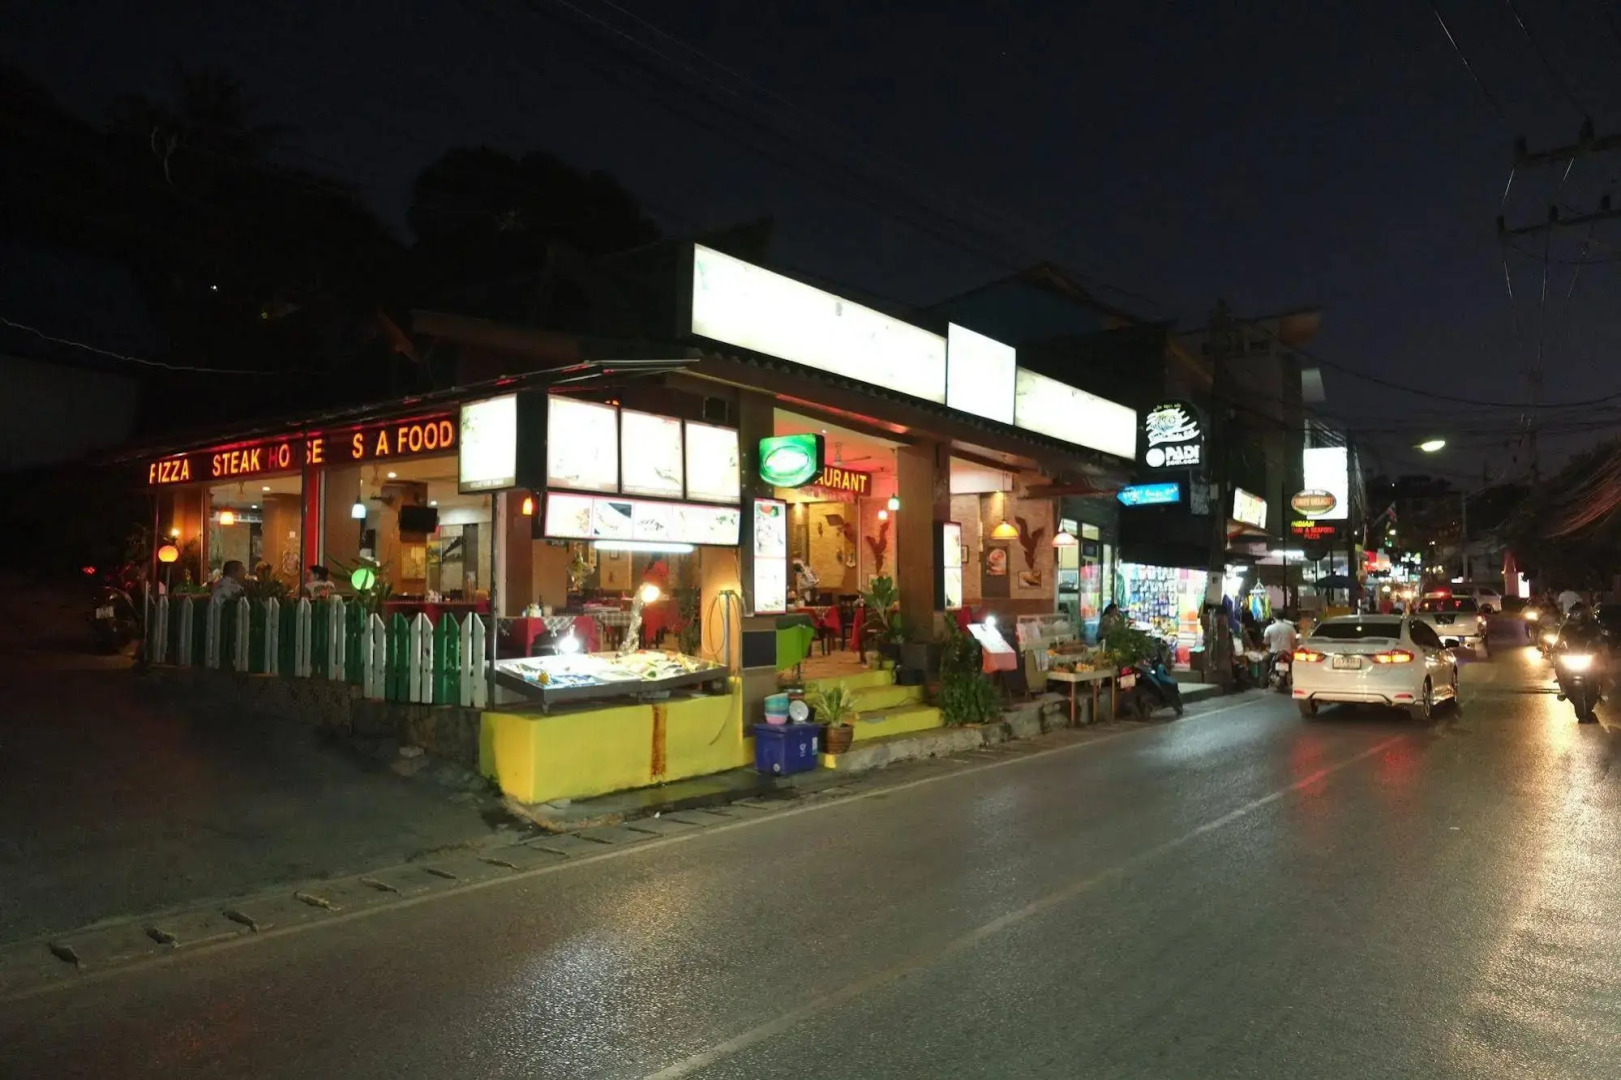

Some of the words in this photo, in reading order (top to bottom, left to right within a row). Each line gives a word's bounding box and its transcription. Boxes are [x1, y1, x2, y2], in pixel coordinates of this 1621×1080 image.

[1165, 444, 1201, 460] PADI
[212, 448, 261, 477] STEAK
[1291, 520, 1315, 528] INDIAN
